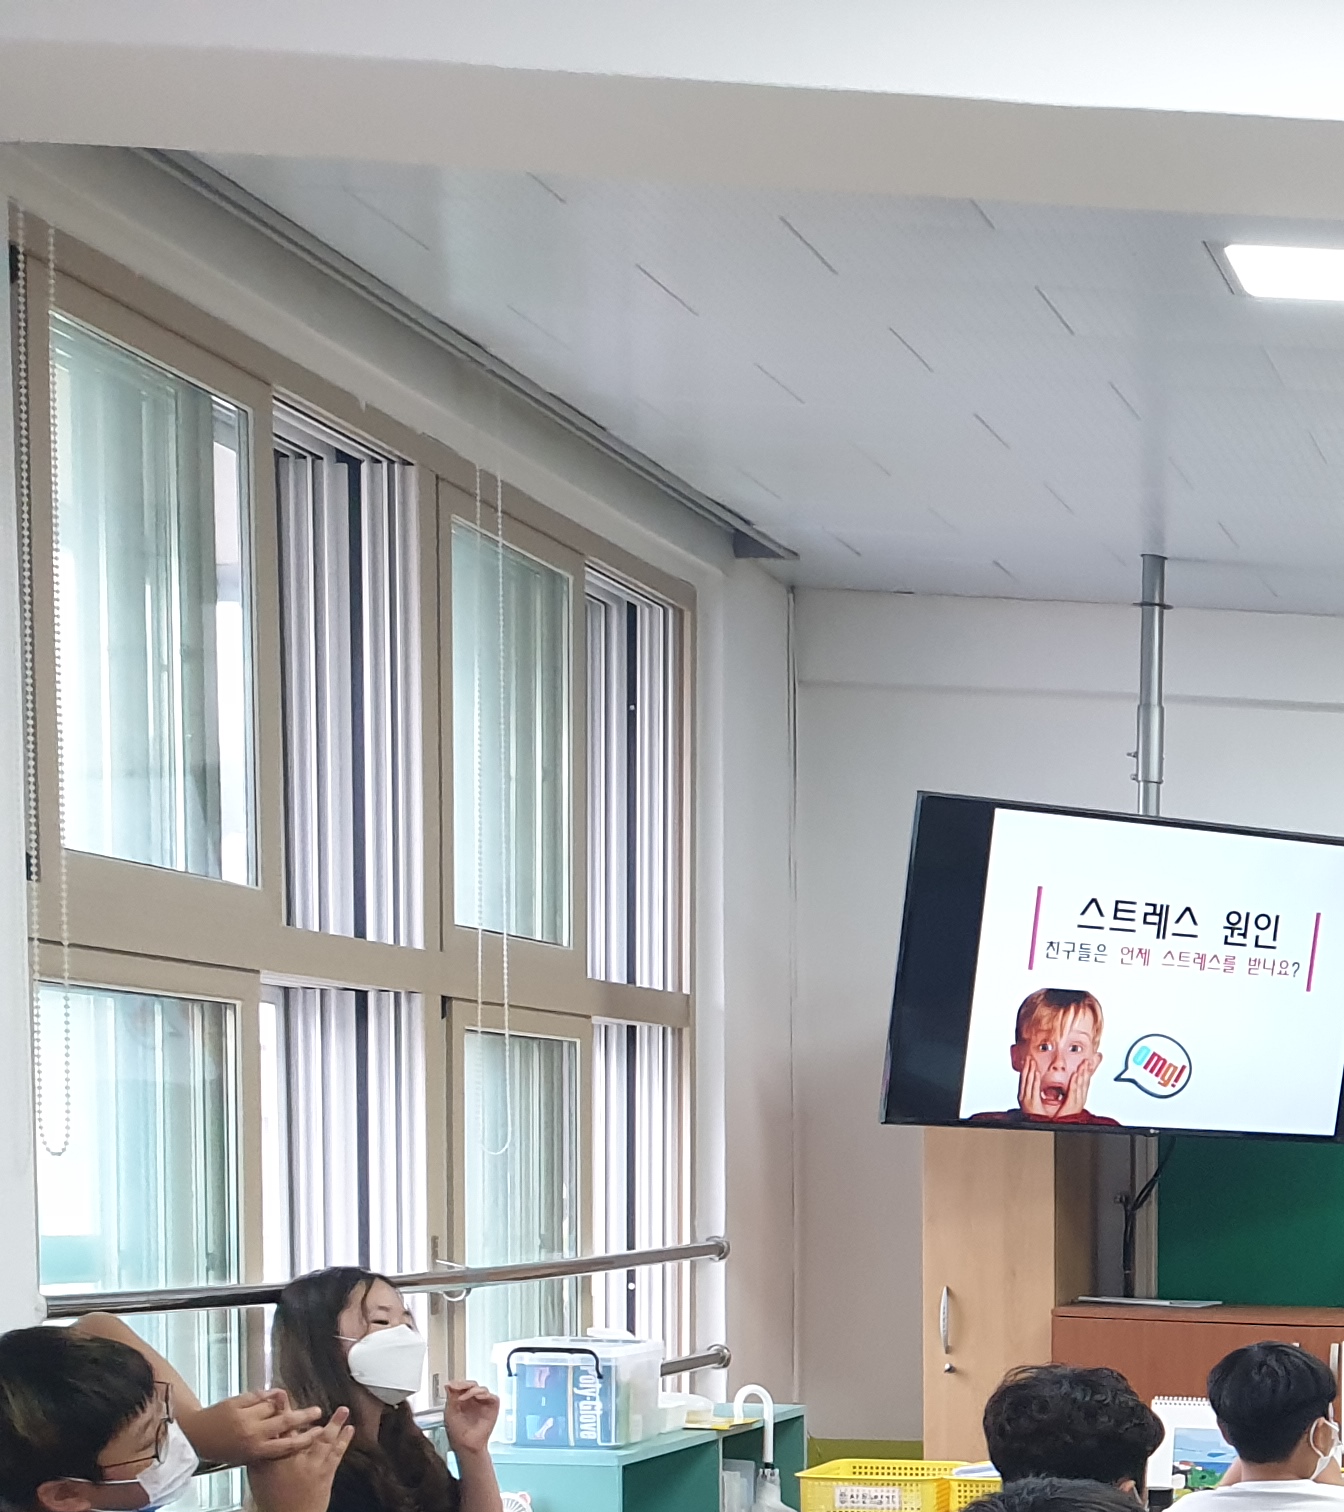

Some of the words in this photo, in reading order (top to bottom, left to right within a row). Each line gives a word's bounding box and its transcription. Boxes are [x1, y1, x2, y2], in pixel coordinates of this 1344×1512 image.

[1076, 897, 1199, 940] 스트레스
[1222, 910, 1281, 950] 원인
[1045, 940, 1108, 964] 친구들은
[1120, 946, 1151, 967] 언제
[1161, 950, 1237, 974] 스트레스를
[1247, 956, 1301, 978] 받나요?
